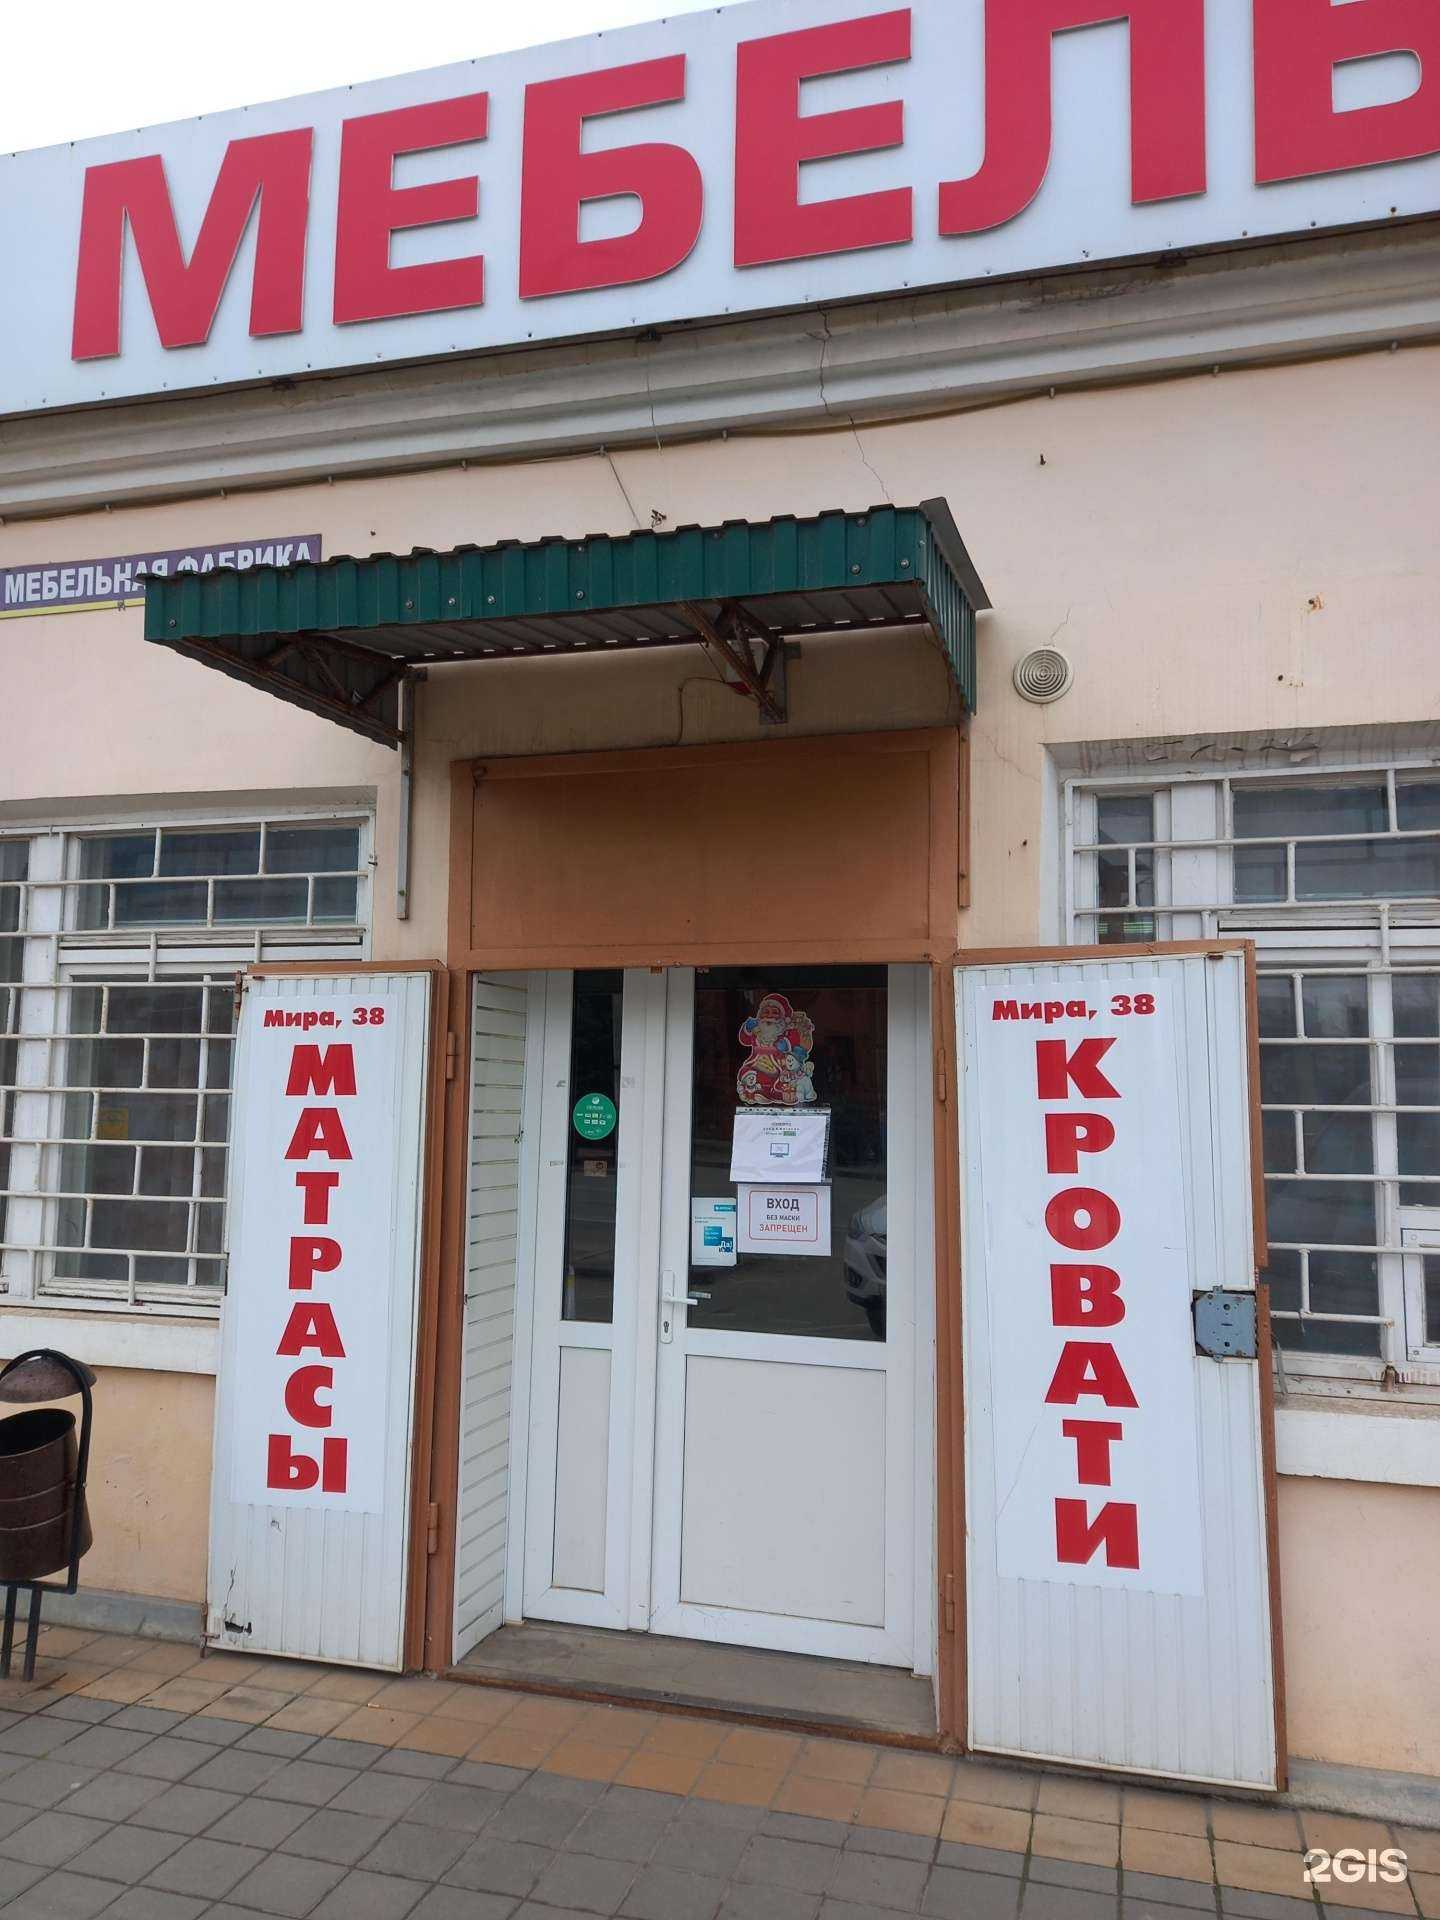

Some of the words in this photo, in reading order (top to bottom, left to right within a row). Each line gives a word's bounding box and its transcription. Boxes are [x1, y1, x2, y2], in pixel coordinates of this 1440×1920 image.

[71, 0, 1440, 360] МЕБЕЛЬ
[264, 1009, 342, 1031] Мира,
[352, 1007, 385, 1025] 38
[992, 999, 1097, 1023] Мира,
[1110, 993, 1155, 1015] 38
[766, 1198, 800, 1211] ВХОД
[759, 1223, 808, 1234] ЗАПРЕЩЕН
[266, 1043, 358, 1493] МАТРАСЫ
[1035, 1037, 1140, 1570] КРОВАТИ
